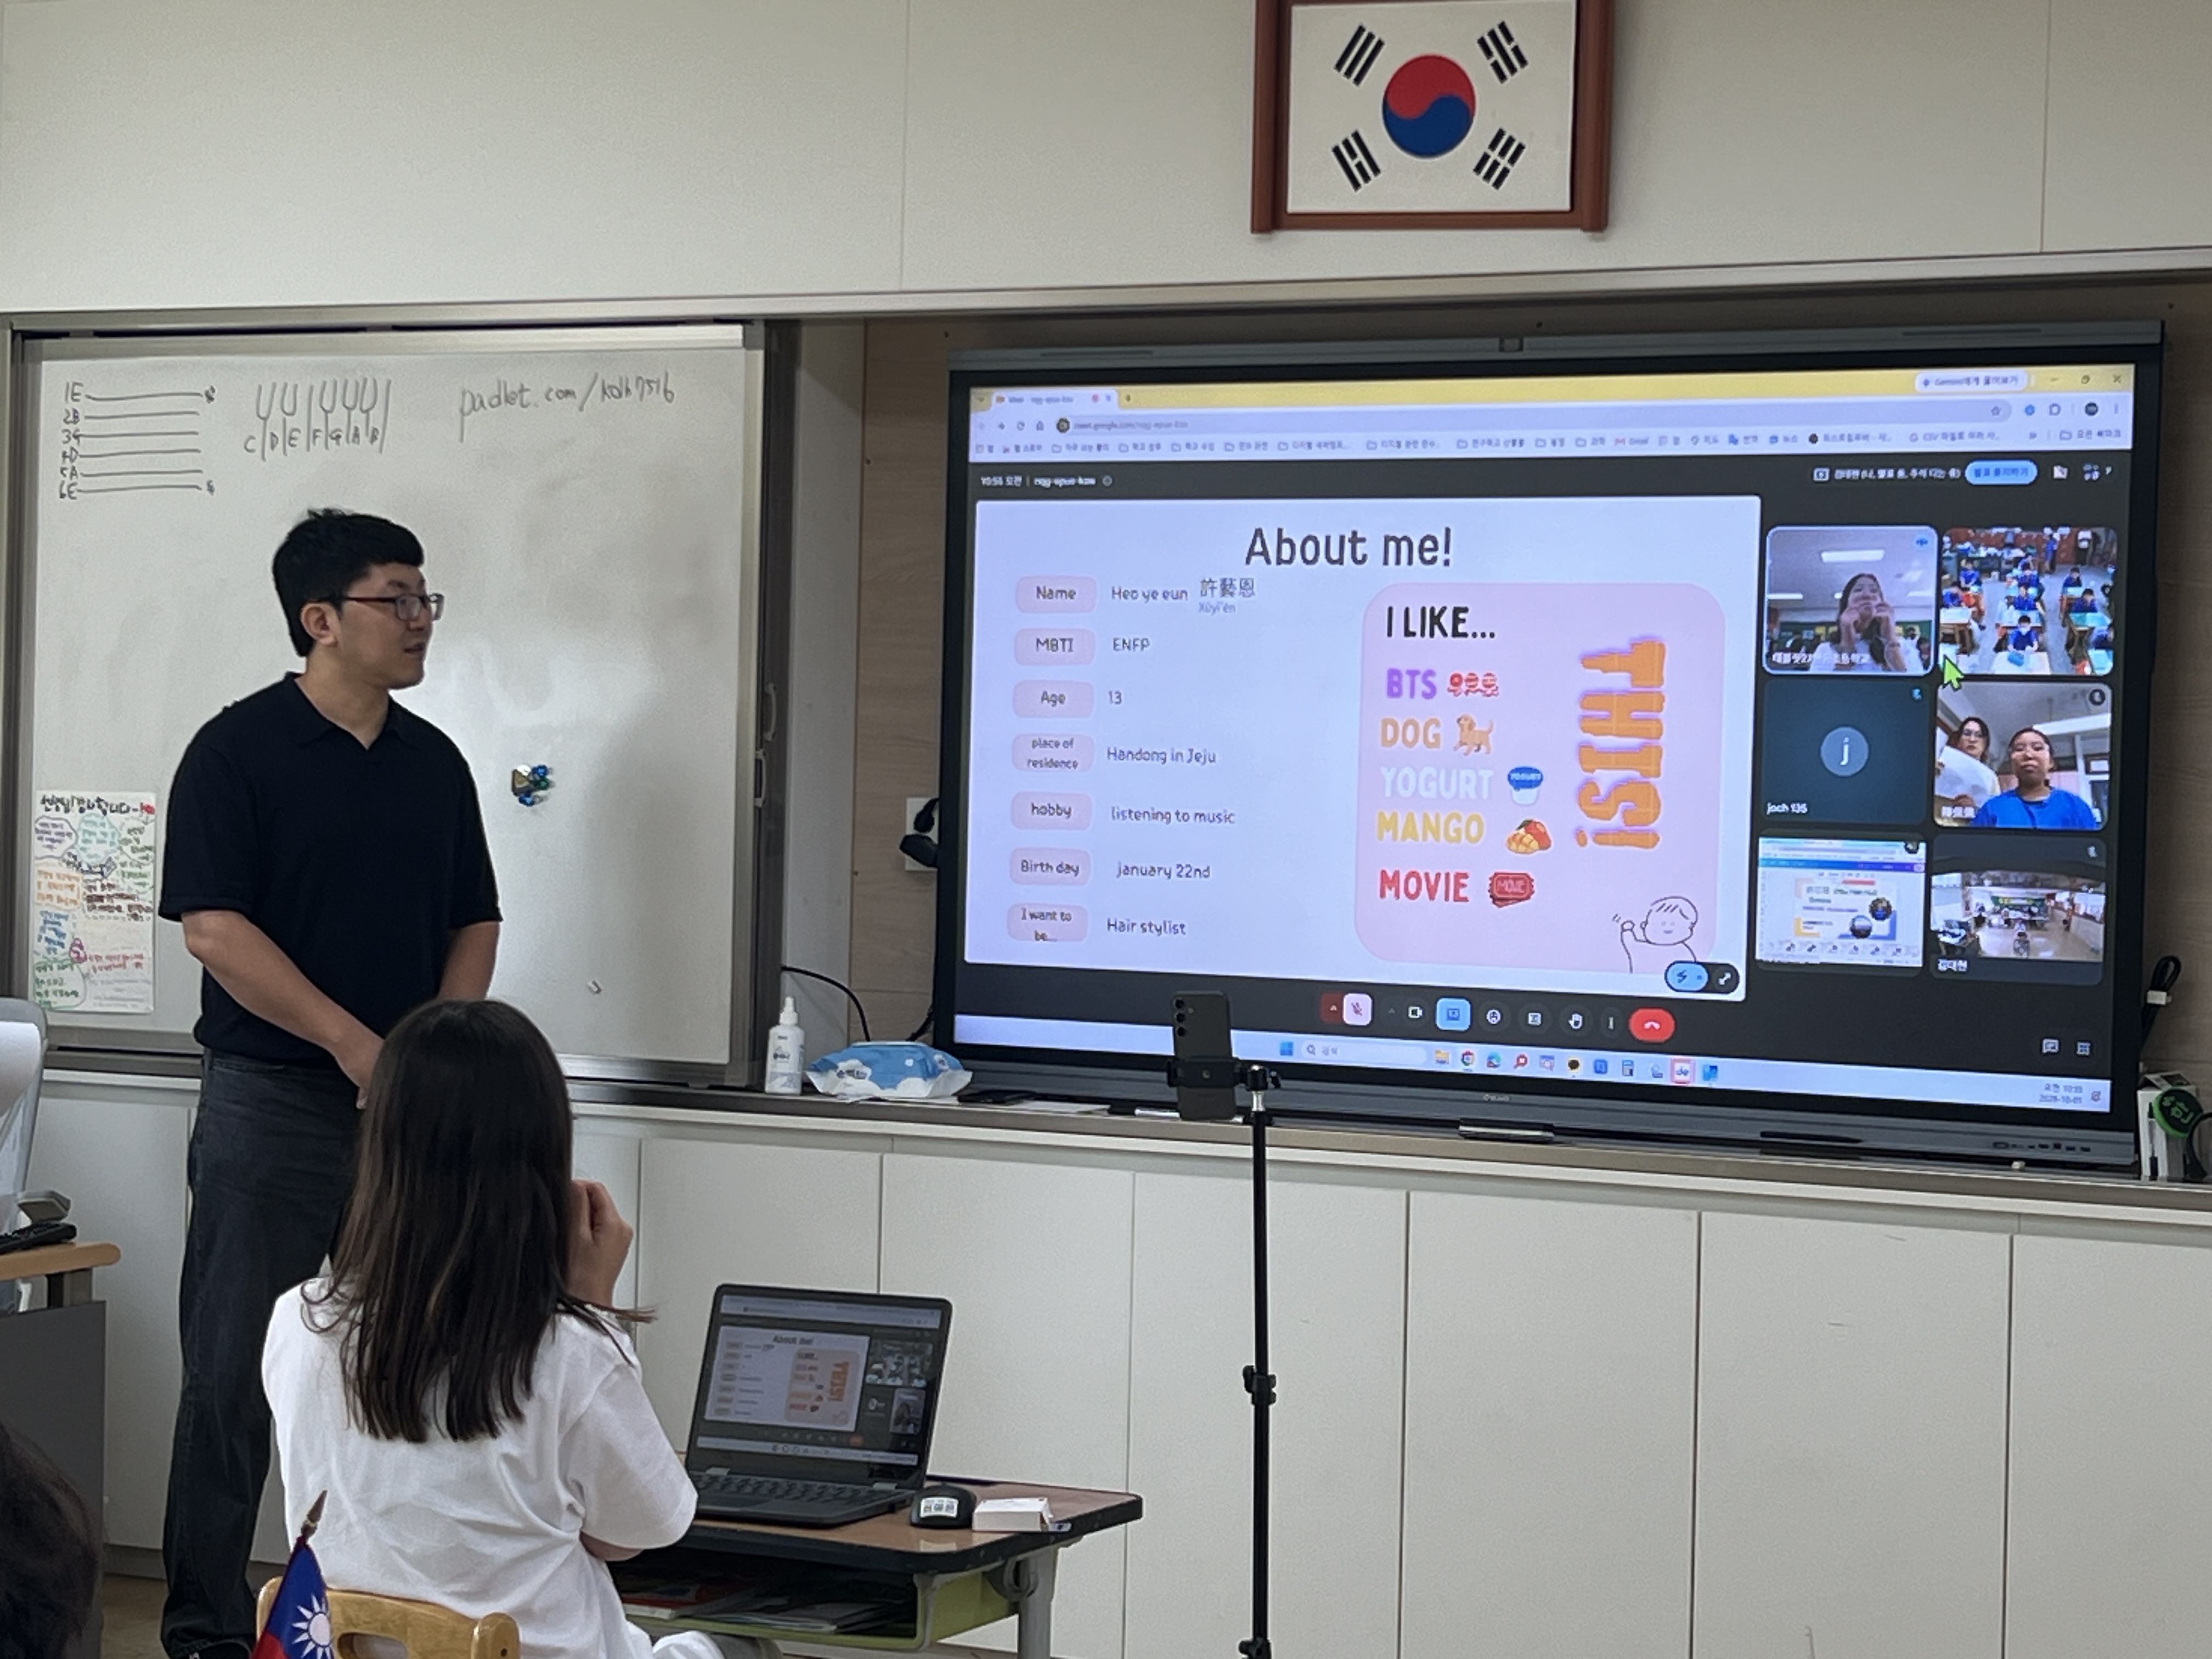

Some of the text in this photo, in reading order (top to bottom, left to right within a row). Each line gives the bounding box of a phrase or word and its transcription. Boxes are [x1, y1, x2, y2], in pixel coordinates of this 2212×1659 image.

[65, 381, 83, 402] 1E
[244, 426, 380, 453] C D E F G A B
[59, 480, 78, 500] 6E
[1245, 526, 1452, 567] About me!
[1036, 585, 1189, 603] Name Heo ye eun
[1386, 606, 1496, 639] I LIKE...
[1035, 637, 1150, 653] MBTI ENFP
[1386, 668, 1437, 700] BTS
[1041, 690, 1123, 707] Age 13
[1031, 737, 1074, 749] place of
[1380, 718, 1442, 748] DOG
[1575, 636, 1667, 849] THIS!
[1107, 747, 1217, 765] Handong in Jeju
[1839, 737, 1850, 766] j
[1026, 757, 1079, 770] residence
[1380, 766, 1494, 800] YOGURT
[1031, 802, 1236, 825] hobby listening to music
[1375, 810, 1485, 845] MANGO
[1020, 860, 1080, 877] Birth day
[1176, 864, 1211, 879] 22nd
[1379, 869, 1470, 902] MOVIE
[1021, 907, 1072, 922] I want to
[1107, 918, 1187, 937] Hair stylist
